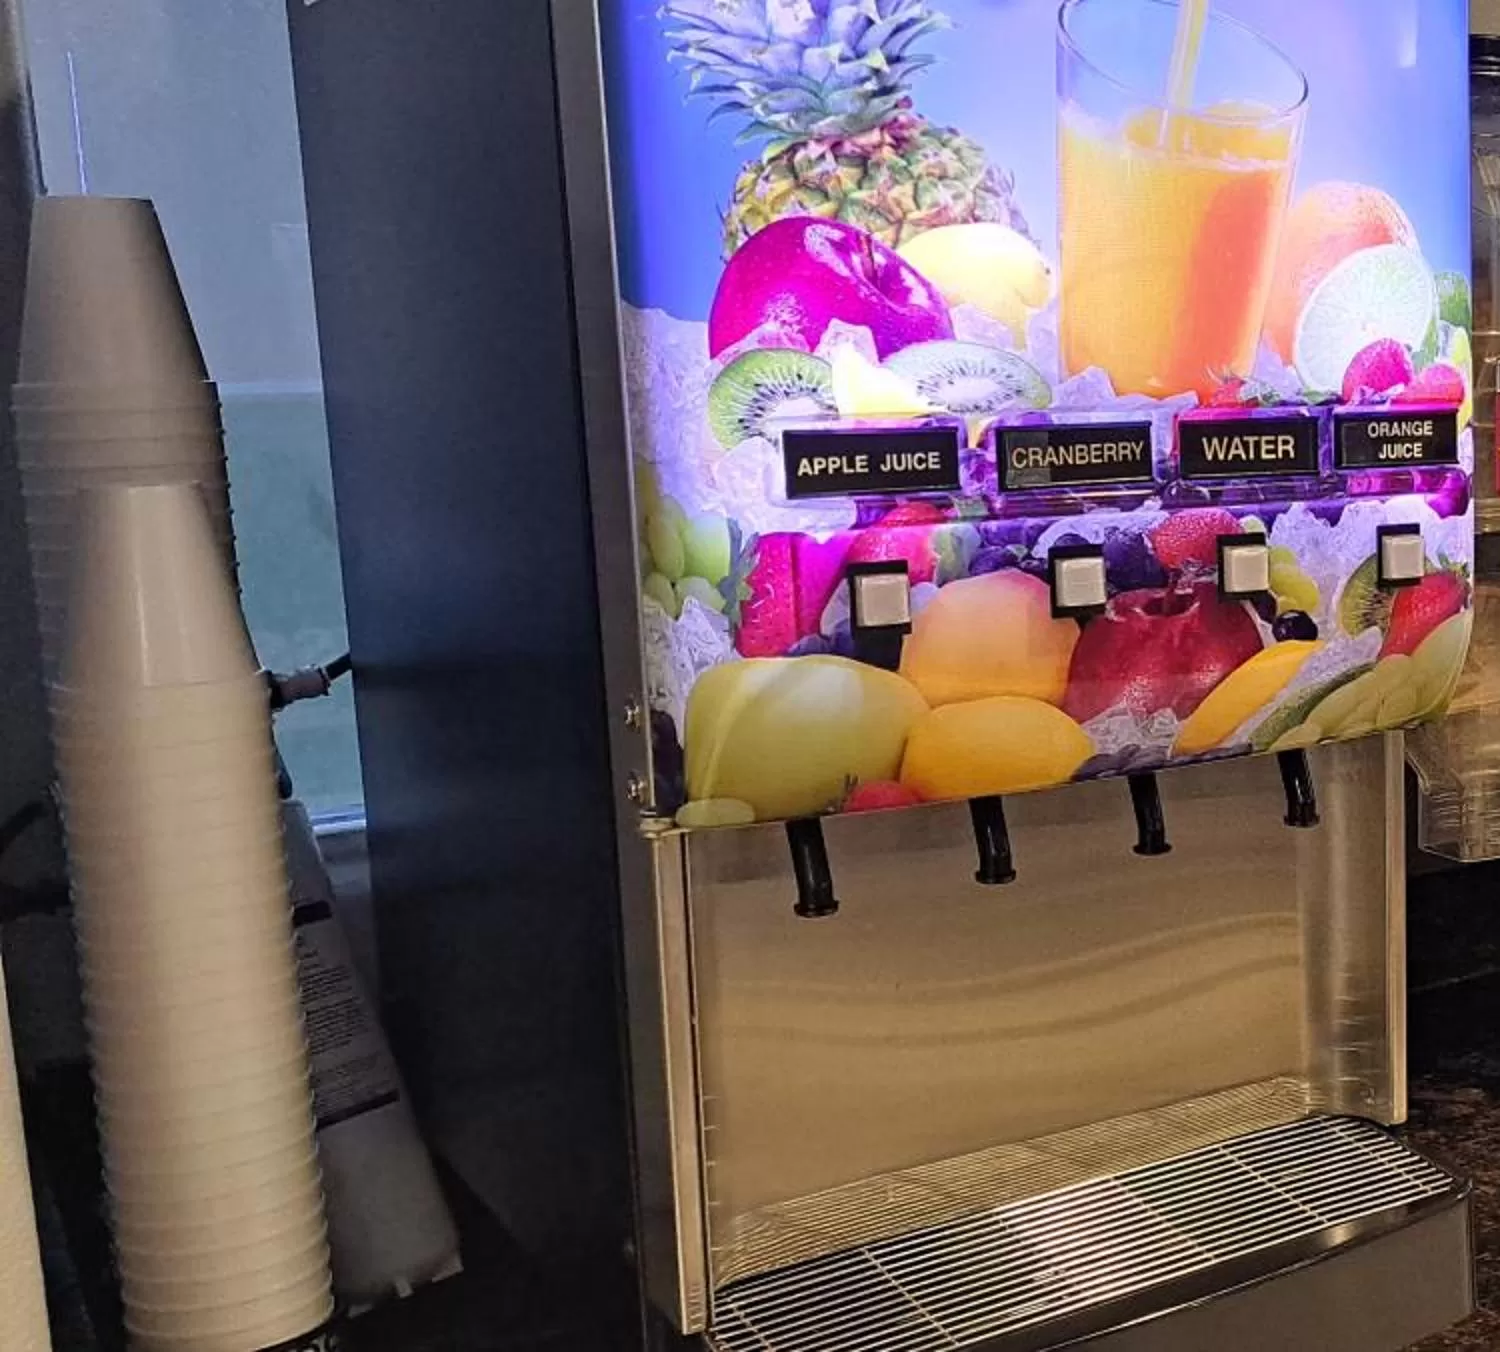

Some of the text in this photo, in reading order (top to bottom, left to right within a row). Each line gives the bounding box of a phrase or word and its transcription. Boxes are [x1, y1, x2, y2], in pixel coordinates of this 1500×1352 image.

[1367, 420, 1433, 439] ORANGE
[1011, 440, 1145, 469] CRANBERRY
[1202, 435, 1296, 462] WATER
[1378, 443, 1423, 460] JUICE
[797, 451, 942, 477] APPLE JUICE
